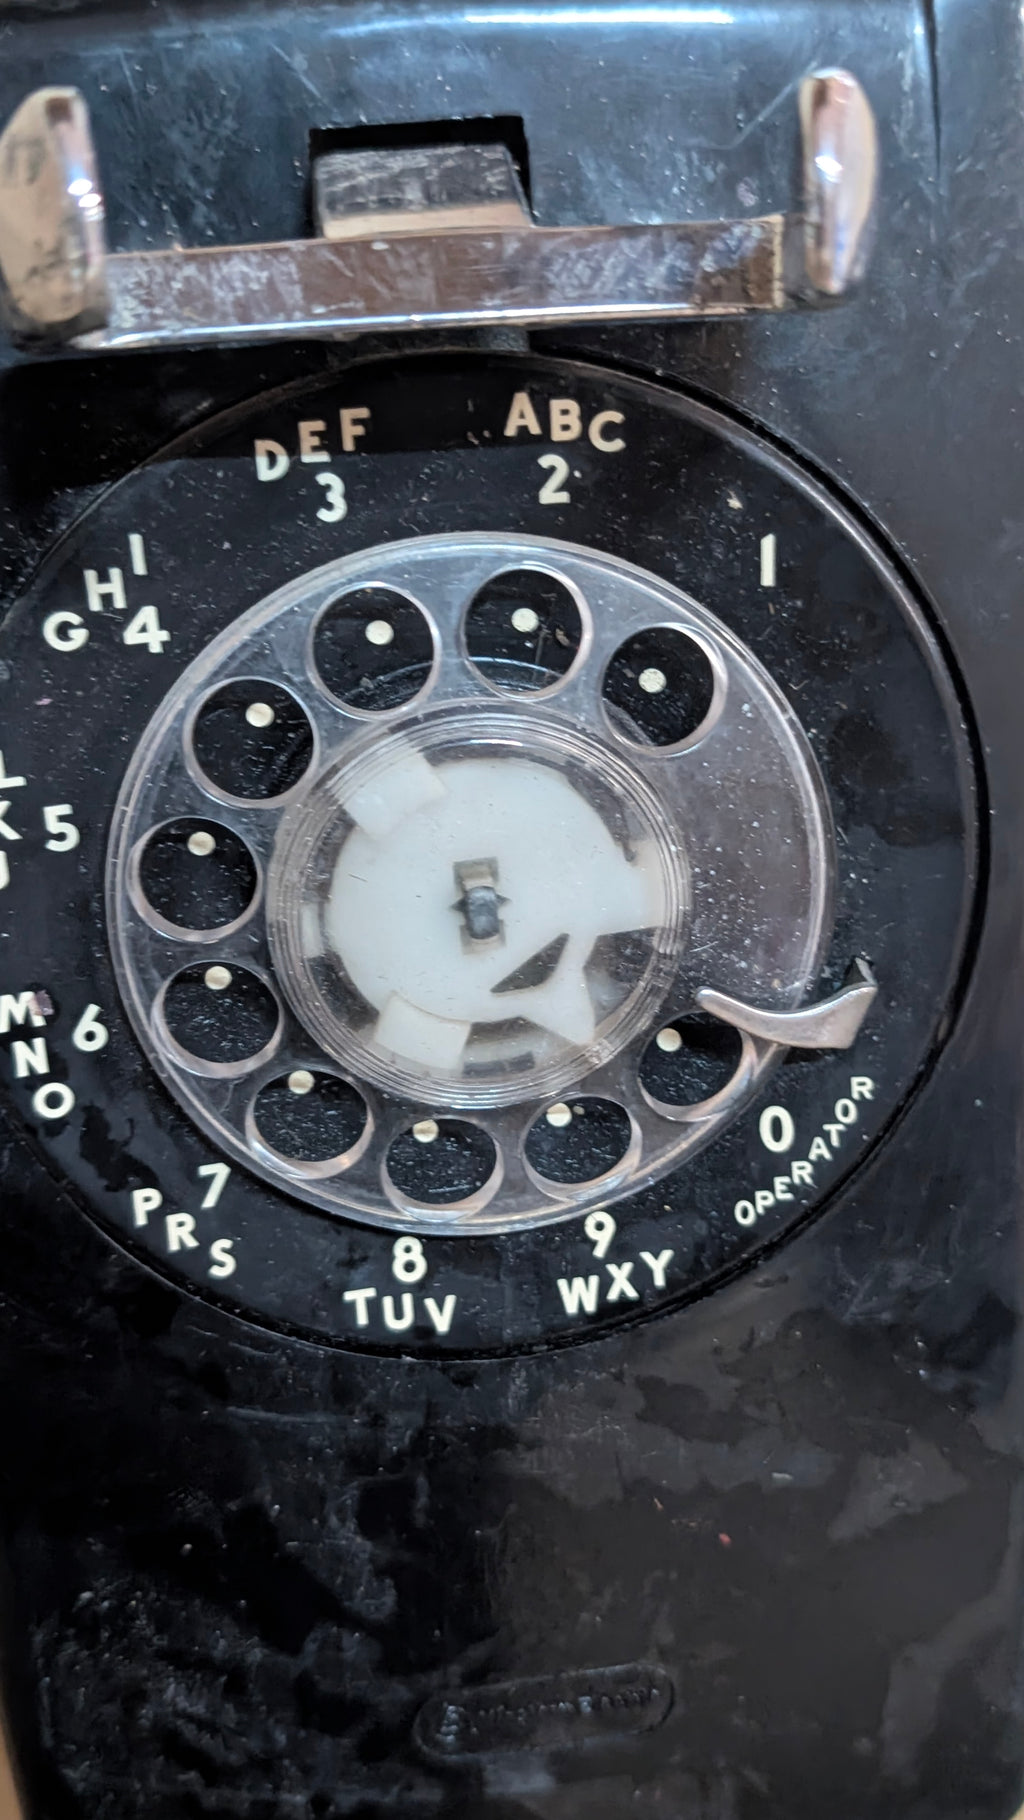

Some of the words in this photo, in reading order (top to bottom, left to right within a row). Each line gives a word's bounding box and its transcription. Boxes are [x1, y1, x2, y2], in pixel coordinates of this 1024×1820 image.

[255, 407, 371, 482] DEF
[505, 392, 626, 453] ABC
[315, 472, 349, 523] 3
[537, 453, 571, 505] 2
[759, 533, 777, 588] 1
[42, 533, 148, 652] GHI
[122, 605, 172, 654] 4
[42, 803, 81, 852] 5
[71, 1003, 109, 1052] 6
[0, 990, 76, 1120] MNO
[733, 1075, 875, 1227] OPERATOR
[758, 1104, 796, 1153] 0
[197, 1162, 232, 1210] 7
[132, 1187, 237, 1279] PRS
[583, 1209, 617, 1259] 9
[391, 1236, 428, 1284] 8
[556, 1248, 675, 1316] WXY
[343, 1287, 458, 1335] TUV
